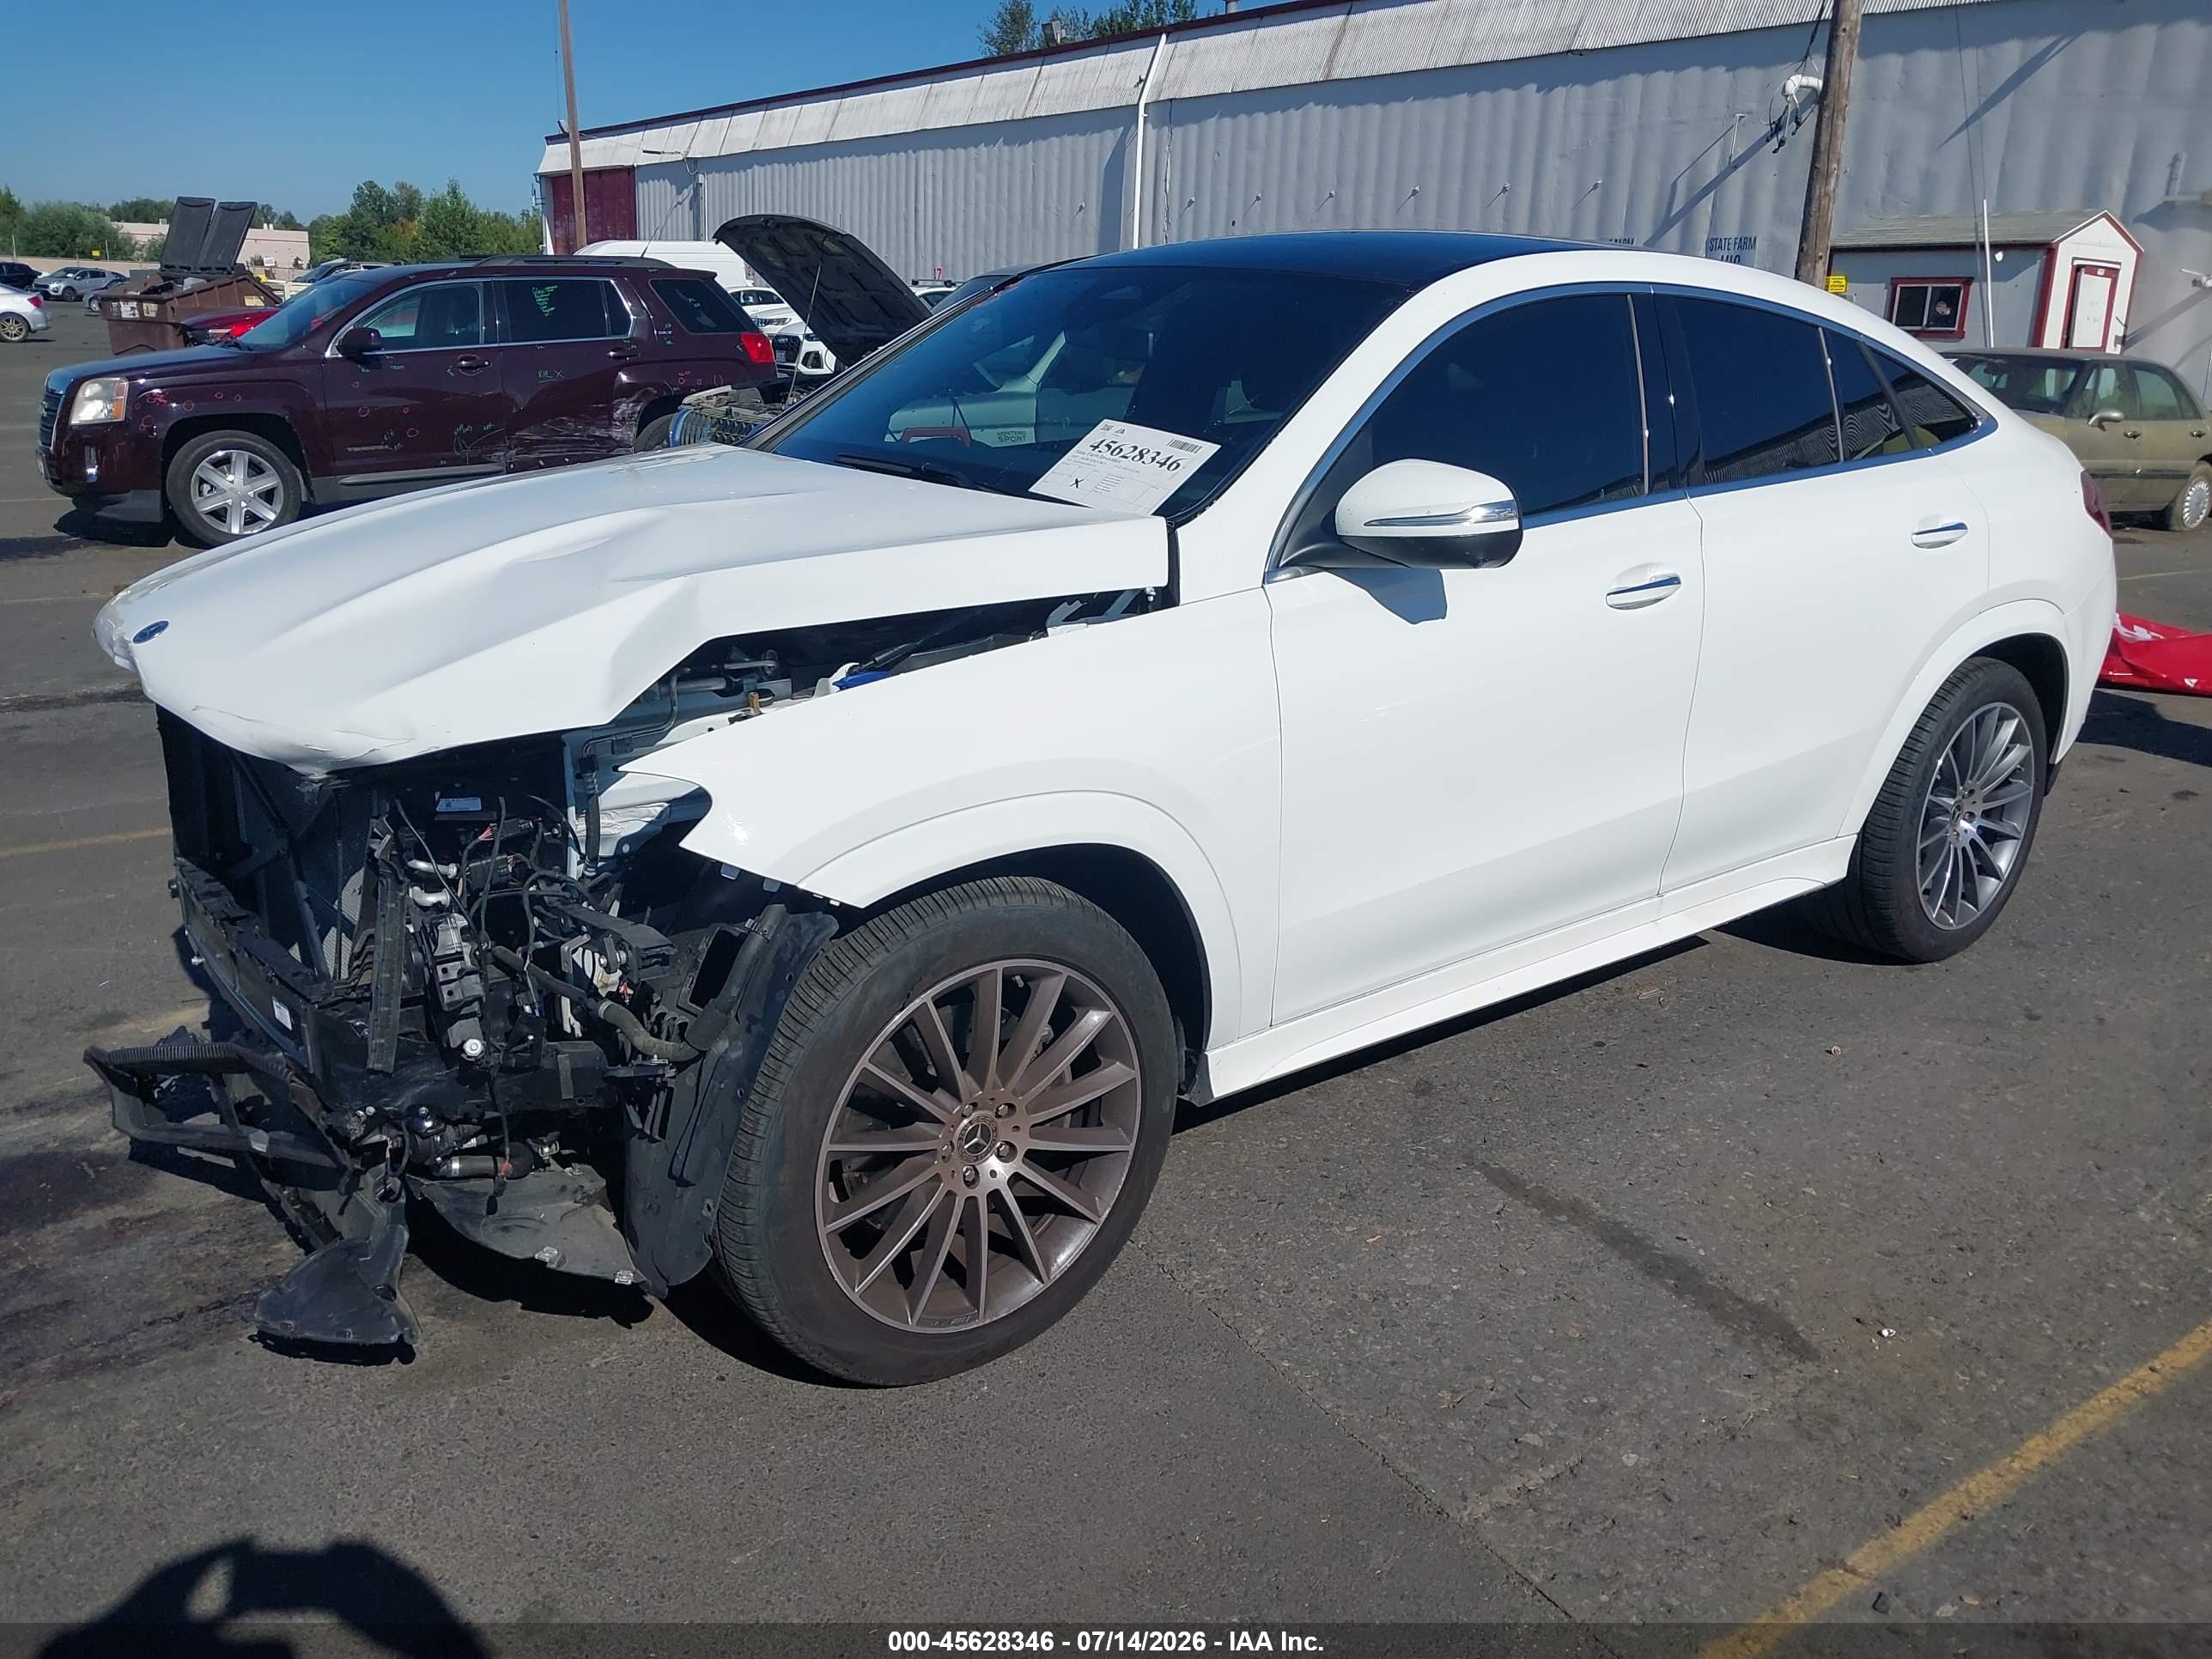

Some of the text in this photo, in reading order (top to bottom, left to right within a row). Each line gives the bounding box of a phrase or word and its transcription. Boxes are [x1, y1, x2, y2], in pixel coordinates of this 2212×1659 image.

[1709, 236, 1757, 252] STATE FARM
[933, 267, 942, 280] 17
[1089, 438, 1188, 471] 45628346
